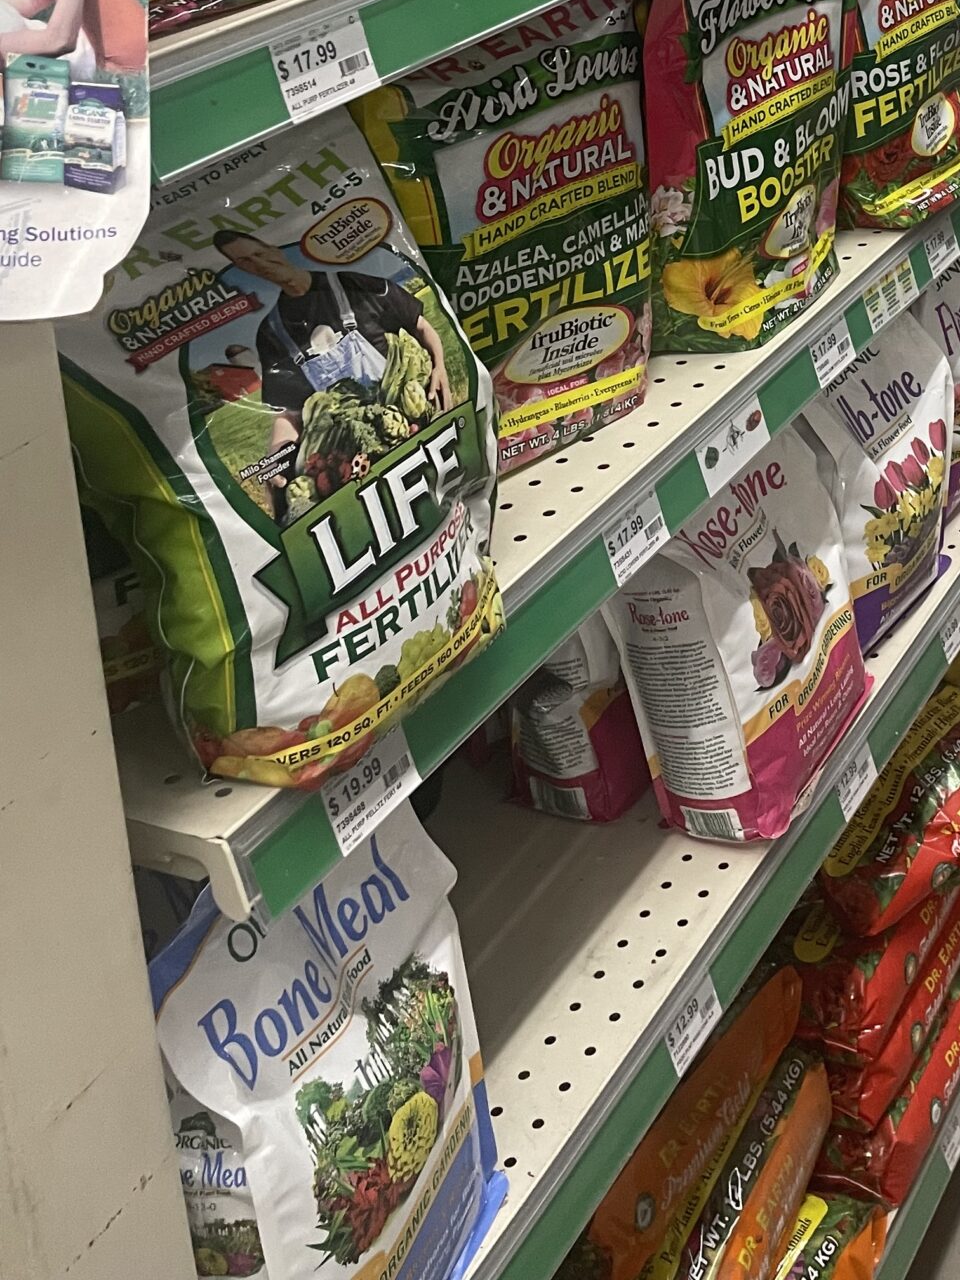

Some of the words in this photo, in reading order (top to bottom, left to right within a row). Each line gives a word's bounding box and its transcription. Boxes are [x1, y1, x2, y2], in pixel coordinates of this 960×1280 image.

[880, 5, 895, 29] &
[882, 28, 910, 52] HAND
[910, 9, 944, 36] CRAFTED
[278, 59, 290, 81] $
[293, 40, 337, 73] 17.99
[726, 11, 828, 81] Organic
[427, 64, 538, 142] Acid
[540, 43, 640, 98] Lovers
[729, 84, 750, 112] &
[744, 43, 834, 104] NATURAL
[850, 58, 912, 101] ROSE
[915, 52, 928, 77] &
[731, 110, 767, 138] HAND
[767, 87, 812, 117] CRAFTED
[487, 94, 622, 184] Organic
[162, 180, 201, 207] EASY
[200, 170, 222, 191] TO
[223, 140, 270, 176] APPLY
[310, 170, 364, 218] 4-6-5
[481, 185, 507, 218] &
[510, 135, 634, 208] NATURAL
[704, 147, 766, 201] BUD
[773, 138, 791, 168] &
[736, 132, 836, 225] BOOSTER
[161, 146, 353, 252] EARTH
[478, 215, 527, 246] HAND
[529, 184, 594, 222] CRAFTED
[597, 169, 635, 193] BLEND
[25, 225, 117, 242] Solutions
[310, 202, 371, 248] TruBiotic
[332, 216, 374, 253] Inside
[456, 244, 559, 288] AZALEA,
[107, 267, 217, 335] Organic
[139, 282, 240, 346] NATURAL
[136, 341, 166, 364] HAND
[164, 319, 211, 348] CRAFTED
[210, 298, 250, 324] BLEND
[538, 333, 600, 365] Inside
[812, 351, 818, 362] $
[817, 332, 837, 359] 17.99
[506, 406, 551, 433] Hydrangeas
[554, 392, 592, 414] Blueberries
[594, 376, 636, 399] Evergreens
[240, 464, 261, 480] Milo
[259, 441, 297, 473] Shammas
[502, 441, 529, 462] NET
[552, 430, 562, 441] 4
[563, 420, 588, 438] LBS.
[878, 429, 900, 452] Flower
[256, 458, 292, 485] Founder
[309, 420, 460, 597] LIFE
[607, 540, 617, 557] $
[616, 515, 644, 547] 17.99
[737, 521, 765, 553] Flower
[865, 571, 889, 591] FOR
[336, 587, 395, 636] ALL
[767, 693, 790, 720] FOR
[797, 652, 827, 707] ORGANIC
[820, 608, 853, 657] GARDENING
[326, 729, 351, 749] 120
[353, 716, 375, 737] SQ.
[376, 700, 394, 720] FT.
[399, 663, 436, 700] FEEDS
[327, 796, 341, 818] $
[341, 757, 382, 803] 19.99
[875, 840, 895, 865] NET
[196, 958, 333, 1093] Bone
[292, 830, 412, 982] Meal
[288, 1048, 309, 1077] All
[309, 1002, 350, 1055] Natural
[675, 997, 700, 1037] 12.99
[702, 1214, 732, 1250] WT.
[740, 1138, 767, 1184] LBS.
[782, 1057, 806, 1090] KG)
[378, 1195, 434, 1280] ORGANIC
[813, 1233, 841, 1271] KG)
